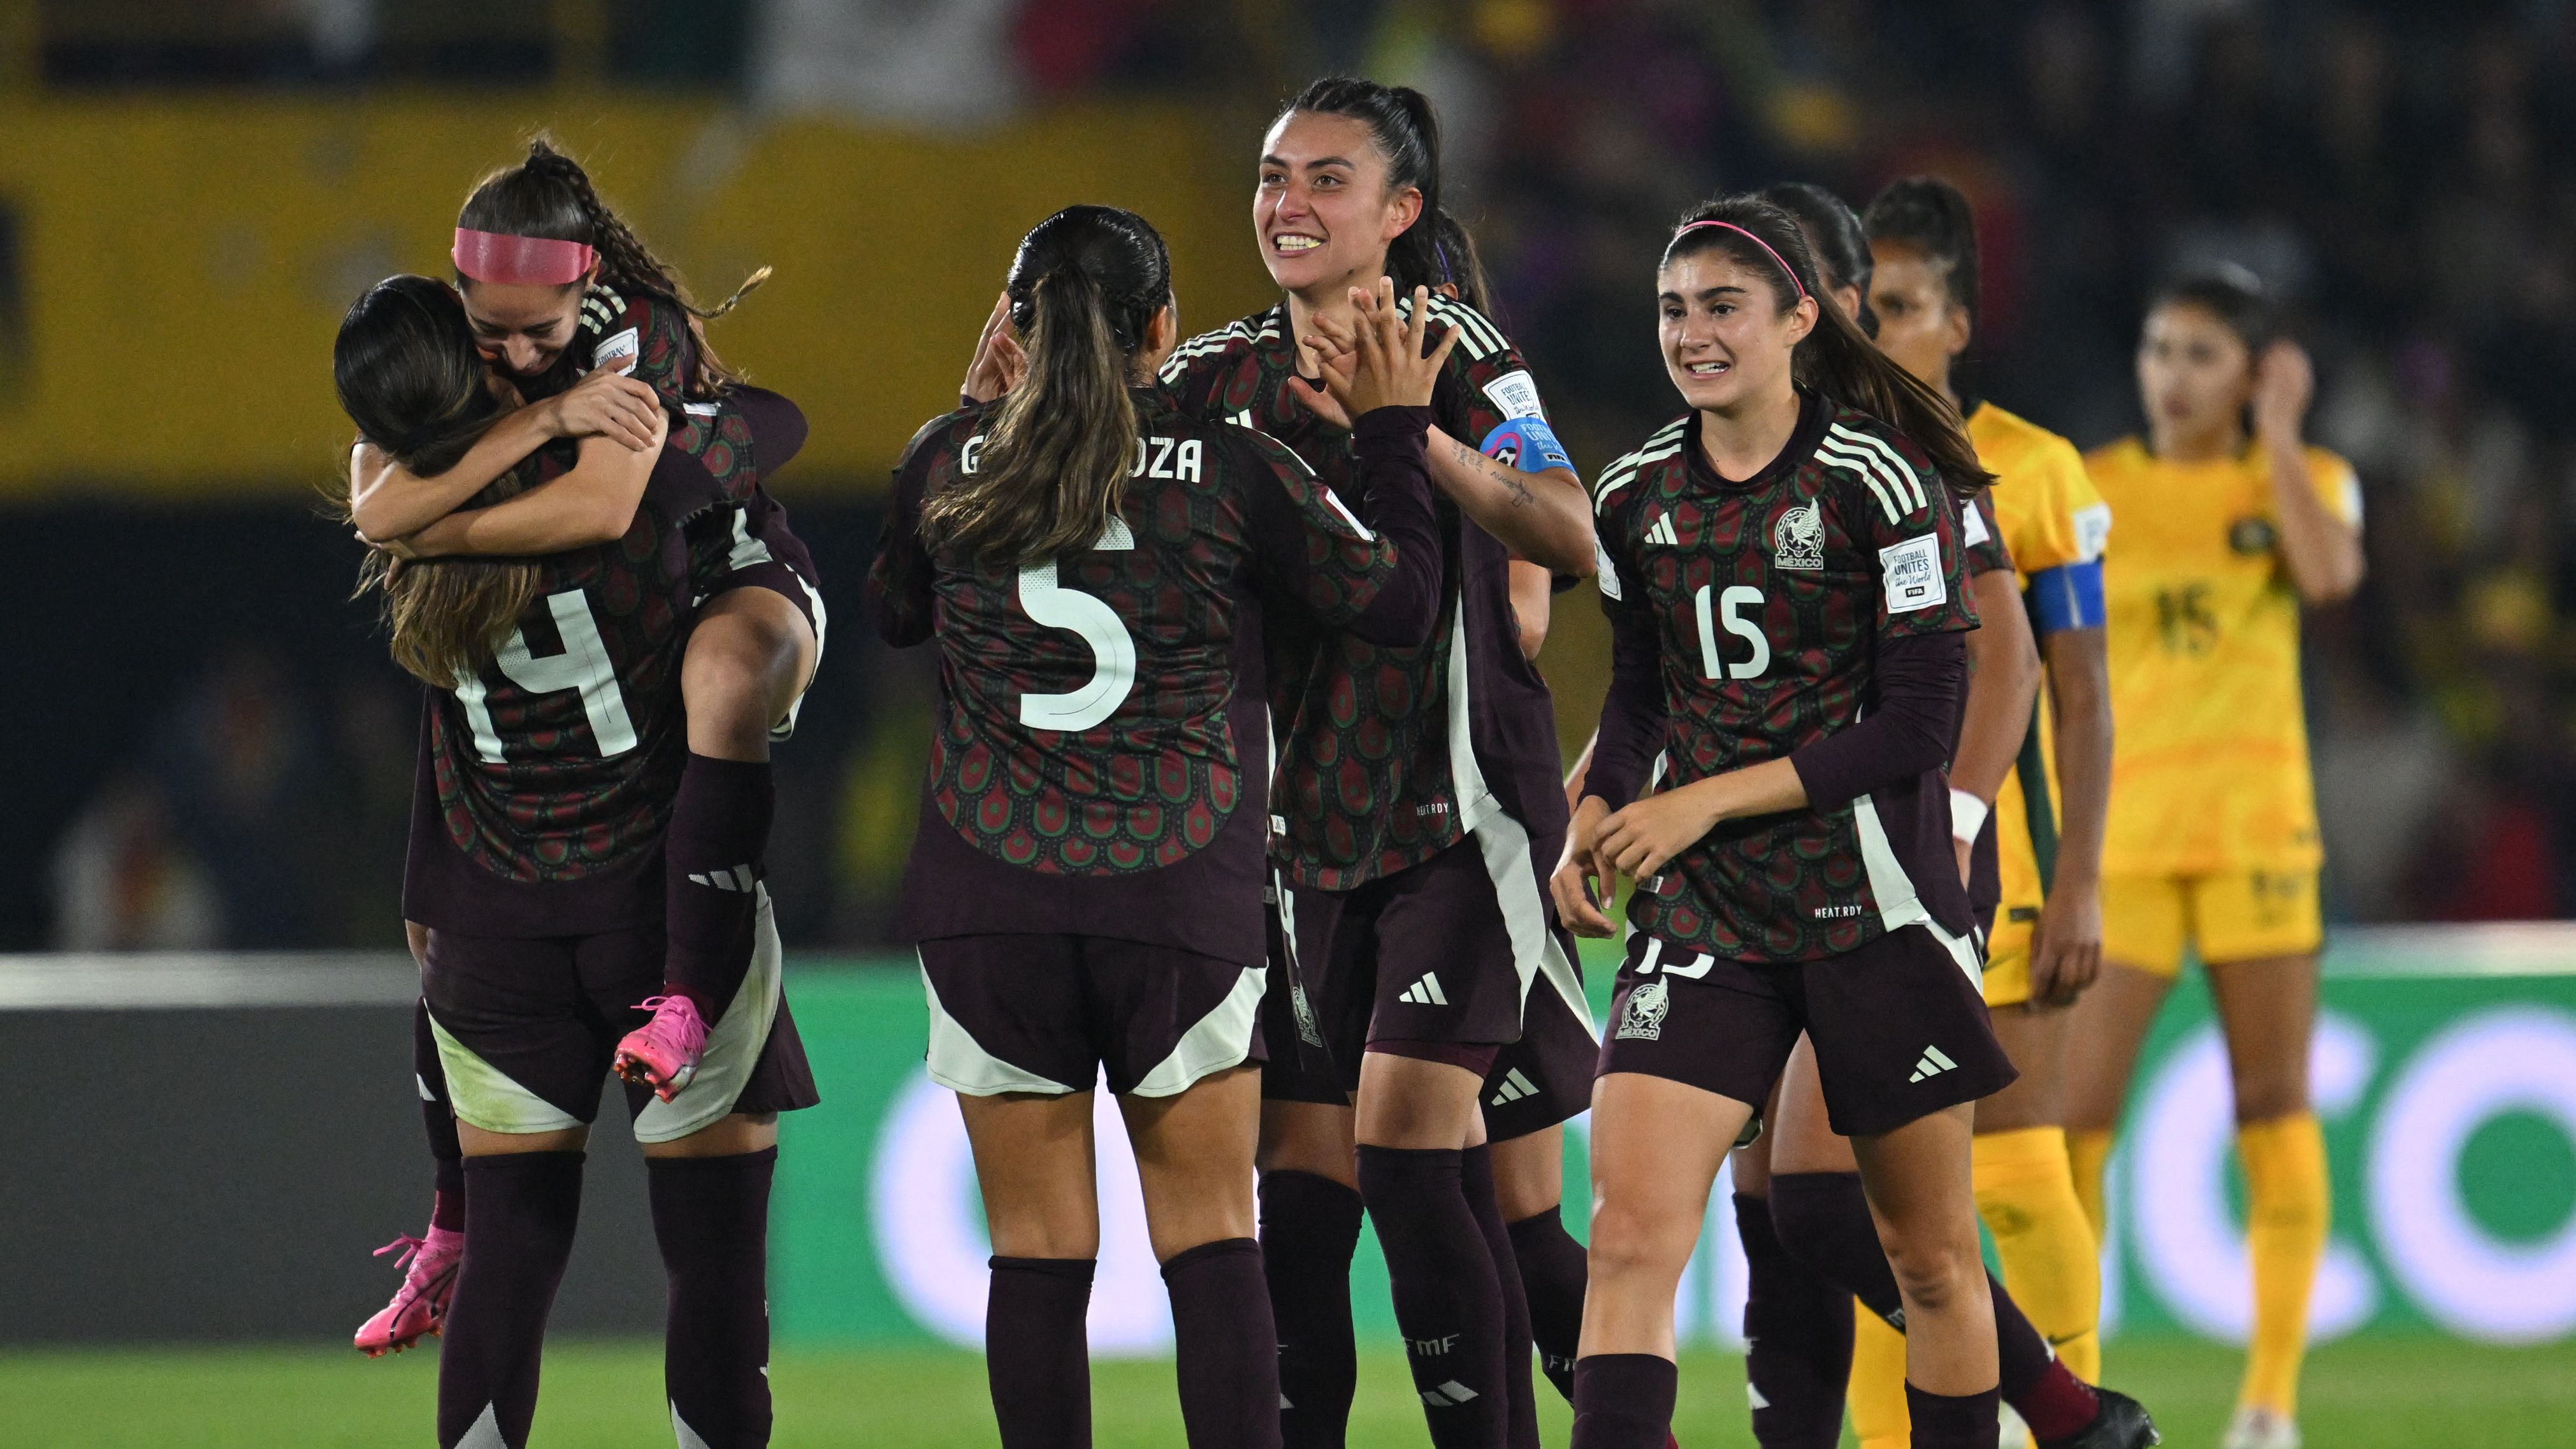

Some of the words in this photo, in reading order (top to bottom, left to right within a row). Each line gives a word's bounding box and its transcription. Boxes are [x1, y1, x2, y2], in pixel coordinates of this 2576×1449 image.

[1893, 549, 1928, 564] FOOTBALL
[1894, 559, 1930, 575] UNITES
[1895, 577, 1907, 587] the
[1909, 570, 1932, 584] World
[1907, 588, 1923, 596] FIFA
[1019, 515, 1136, 732] 5
[1695, 585, 1770, 679] 15
[1814, 905, 1862, 918] HEAT.RDY
